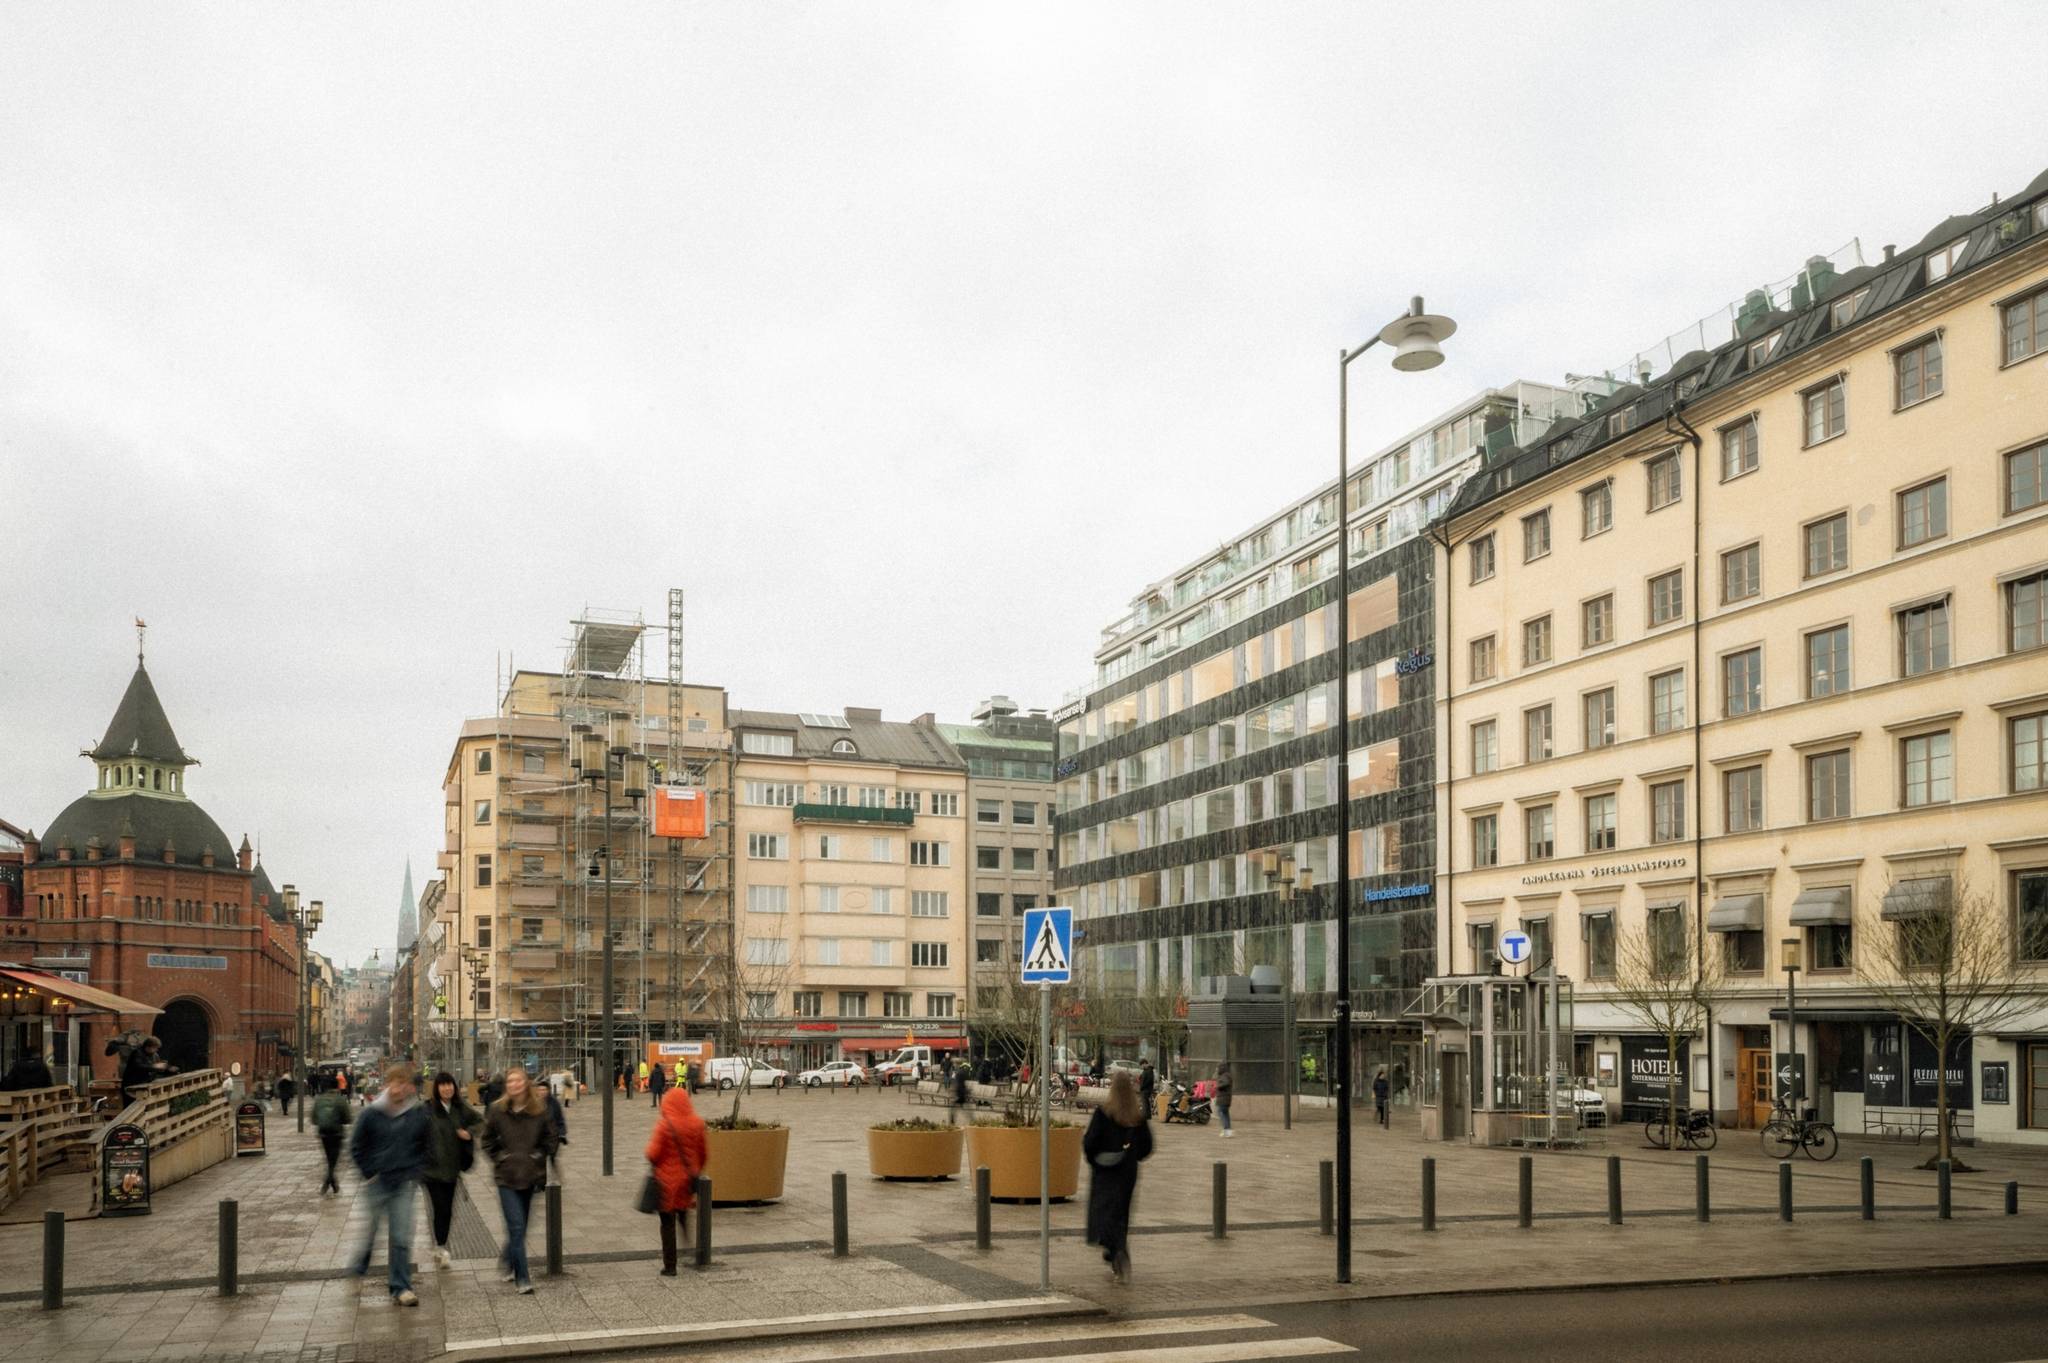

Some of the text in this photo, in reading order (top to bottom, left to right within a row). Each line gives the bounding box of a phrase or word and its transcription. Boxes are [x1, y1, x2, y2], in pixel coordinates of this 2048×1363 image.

[1591, 857, 1687, 878] ÖSTERMALMSTORG
[1364, 883, 1430, 902] Handelsbanken
[1504, 937, 1526, 959] T
[1631, 1074, 1683, 1083] ÖSTERMALMSTRG
